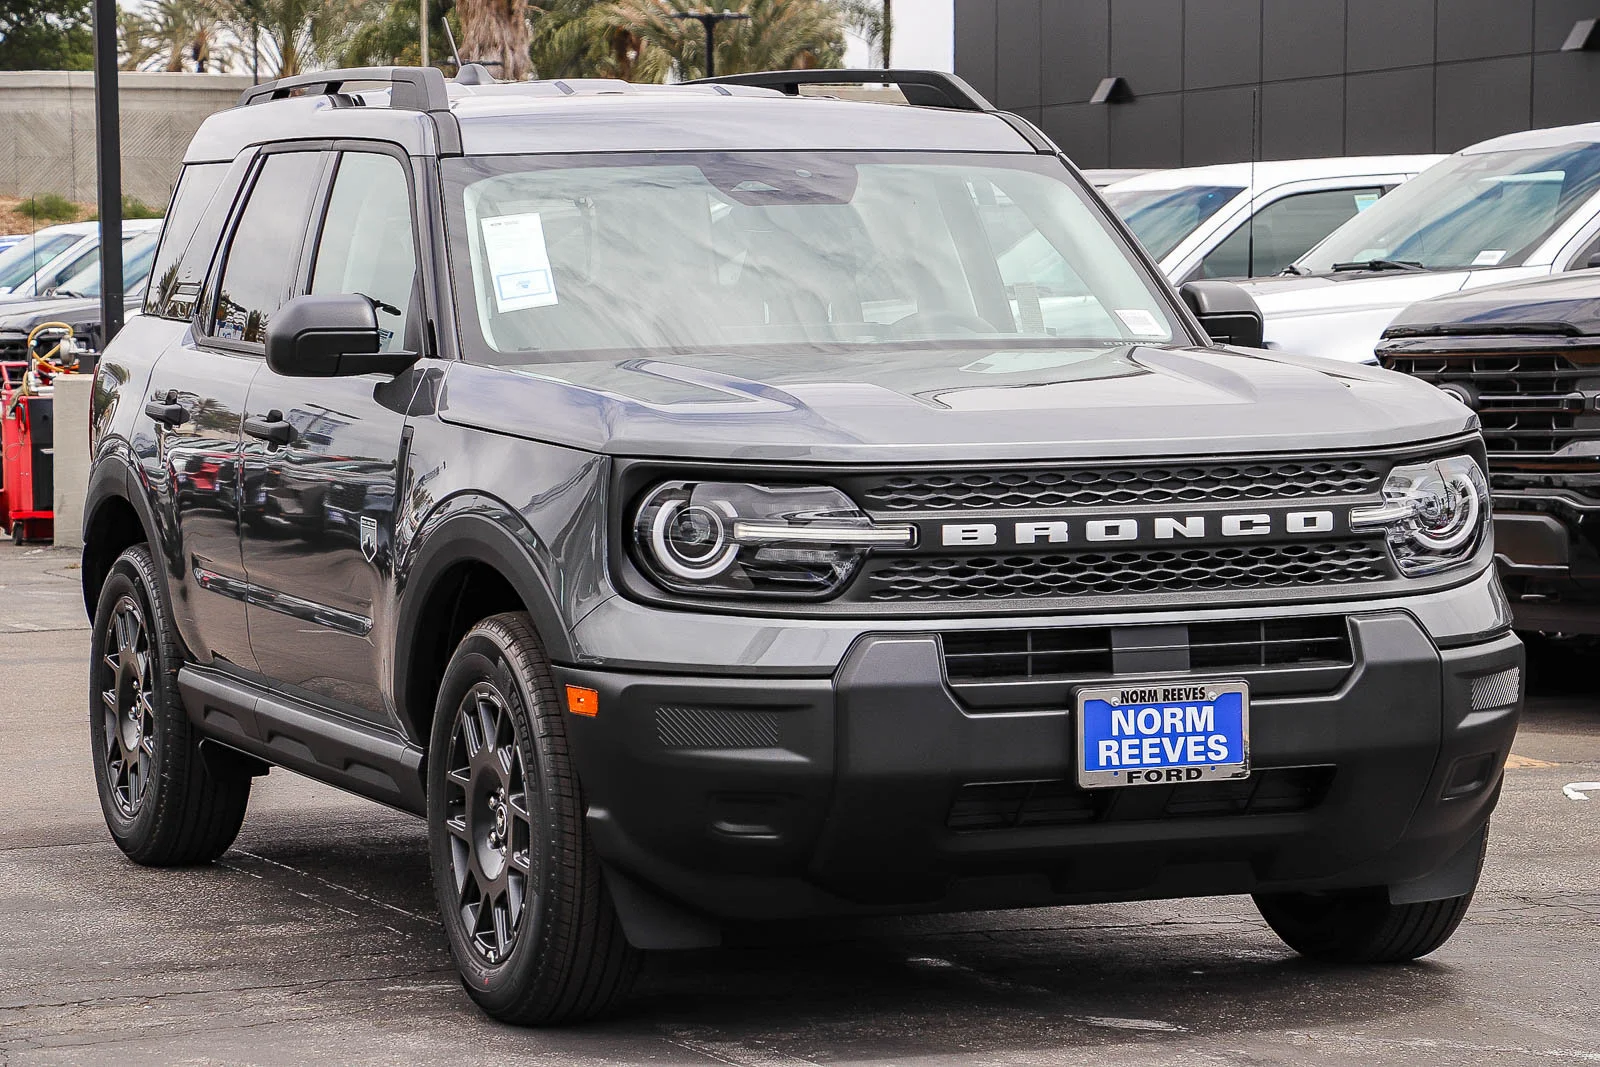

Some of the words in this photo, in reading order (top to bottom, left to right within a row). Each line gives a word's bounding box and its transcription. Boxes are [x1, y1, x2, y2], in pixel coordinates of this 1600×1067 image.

[941, 510, 1333, 546] BRONCO
[1120, 690, 1158, 704] NORM
[1162, 687, 1206, 702] REEVES
[1111, 706, 1215, 736] NORM
[1098, 734, 1229, 766] REEVES
[1127, 768, 1203, 783] FORD
